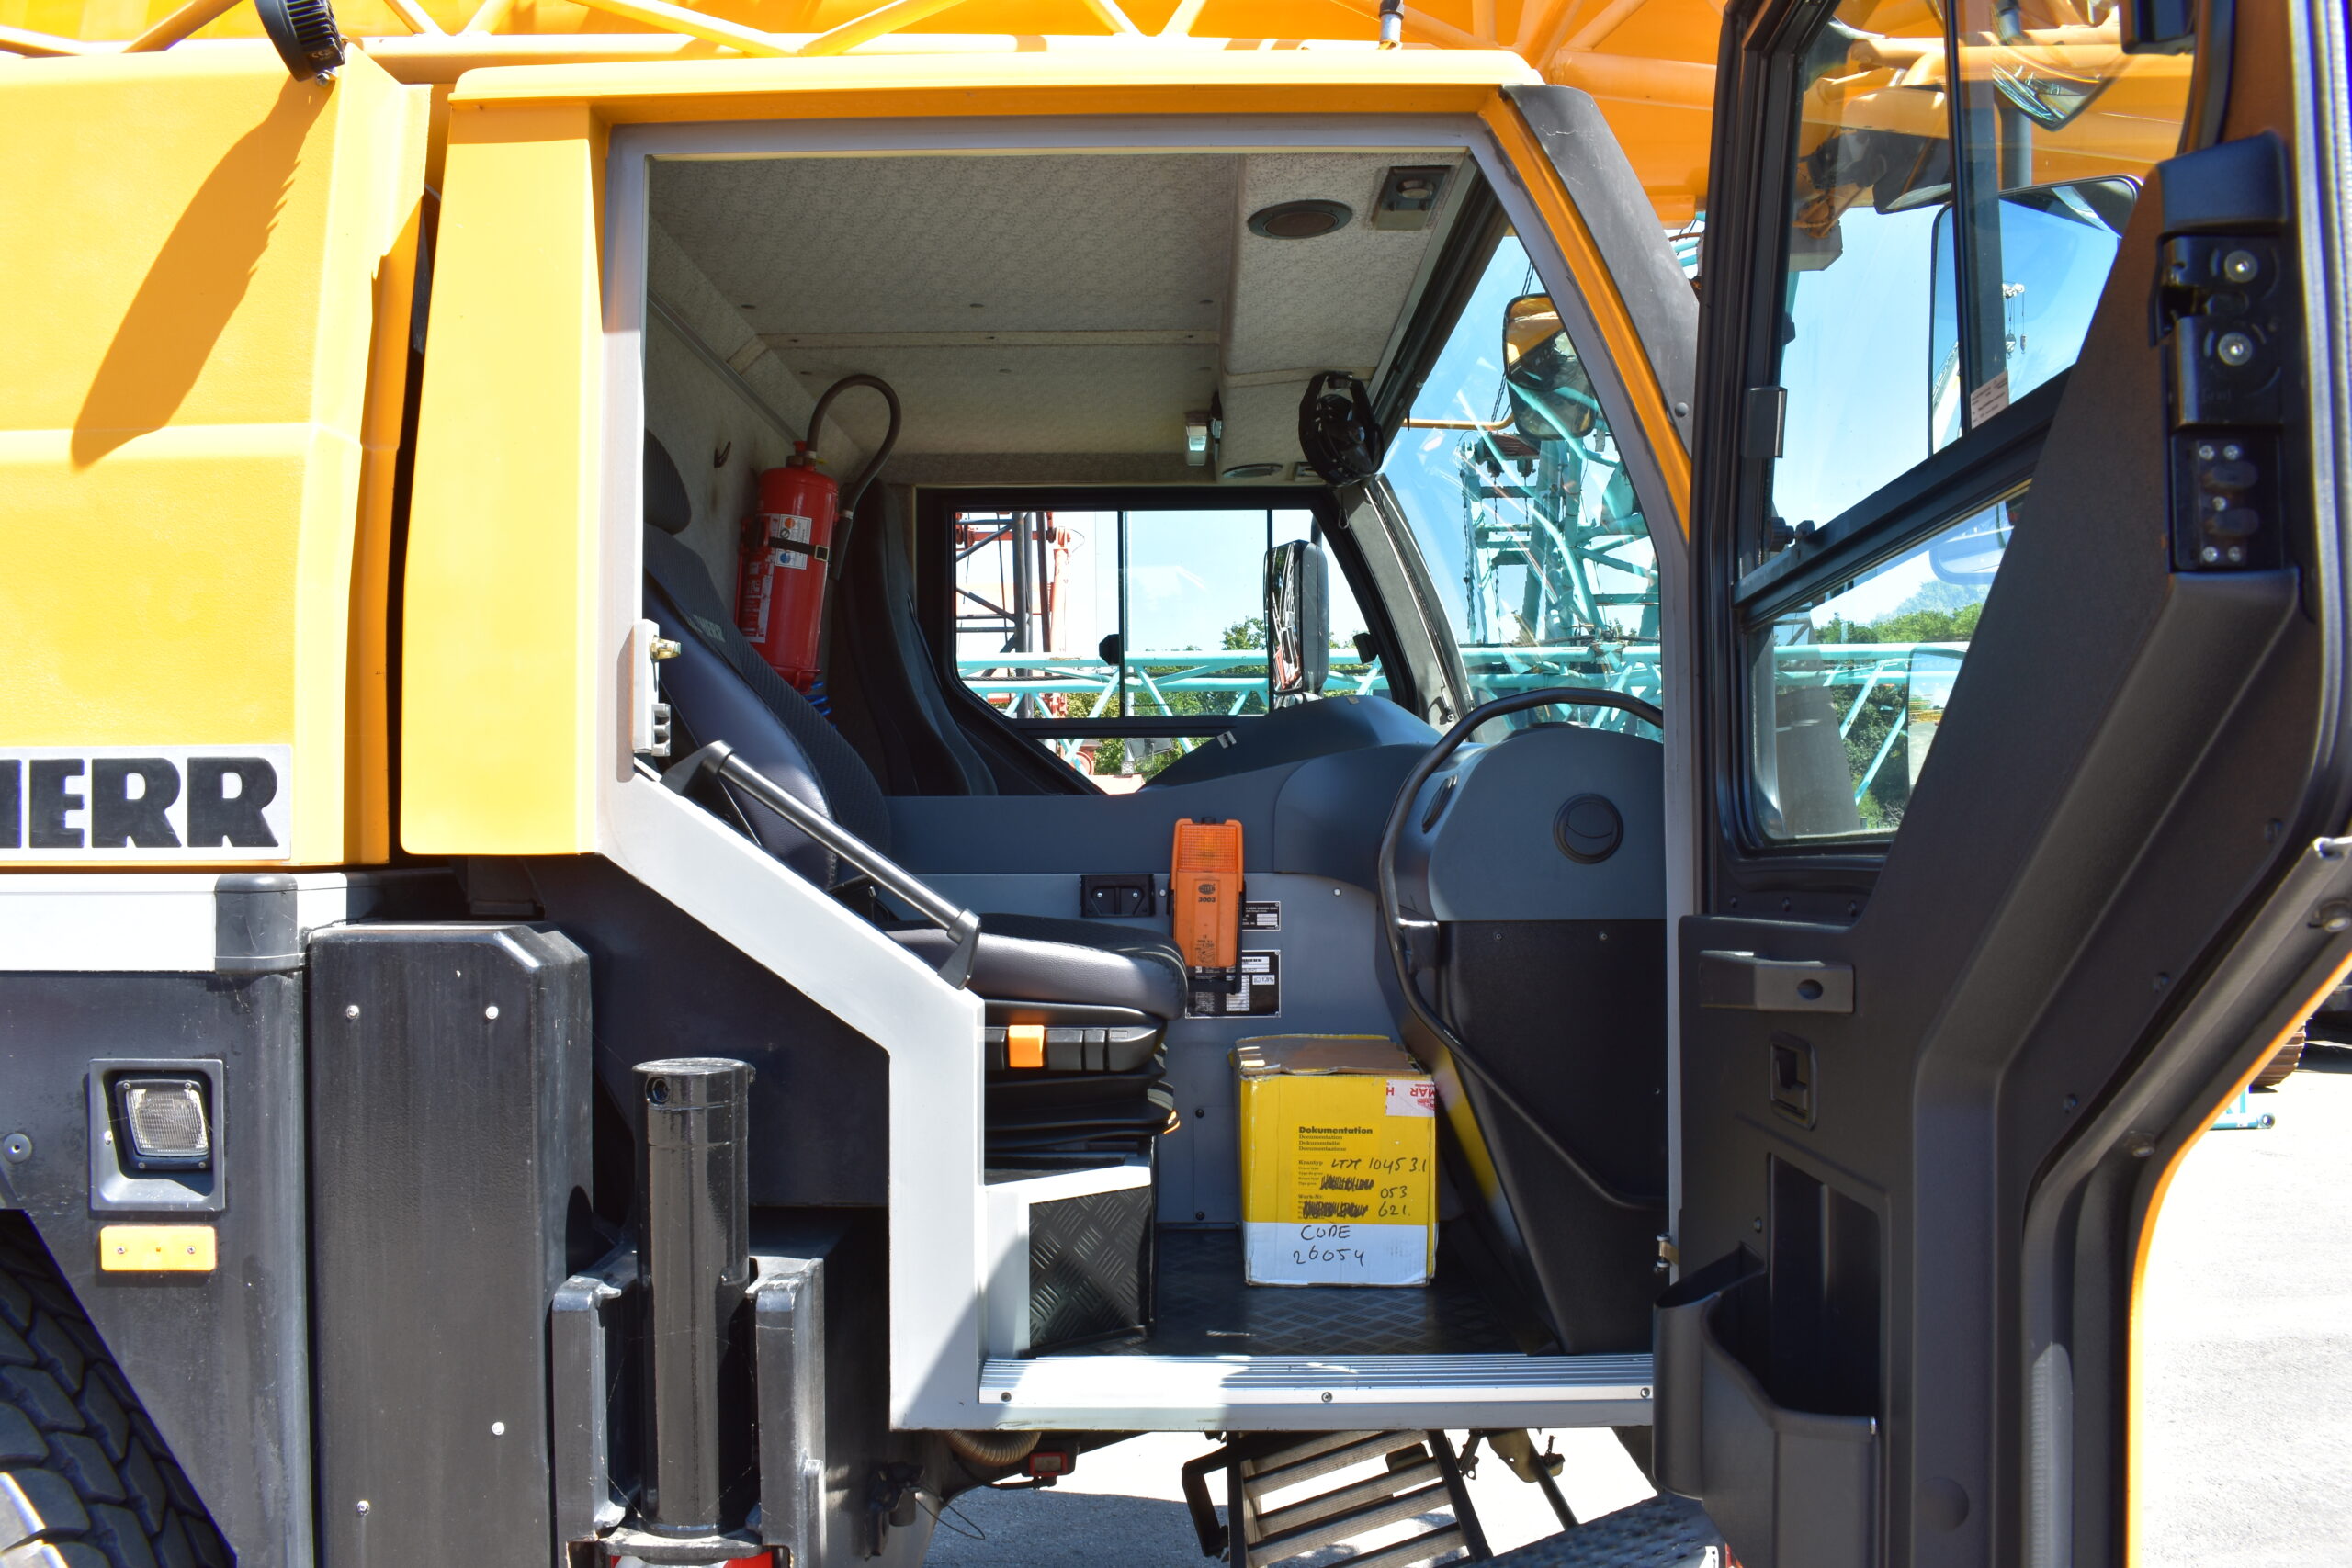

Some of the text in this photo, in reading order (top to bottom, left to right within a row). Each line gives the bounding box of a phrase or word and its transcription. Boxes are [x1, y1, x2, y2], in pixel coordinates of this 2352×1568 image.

[1298, 1126, 1374, 1134] Dokumentation
[1369, 1157, 1407, 1175] 1045
[1409, 1157, 1427, 1173] 3.1
[1380, 1185, 1408, 1199] 053
[1301, 1224, 1351, 1240] CODE
[1293, 1245, 1364, 1267] 26054
